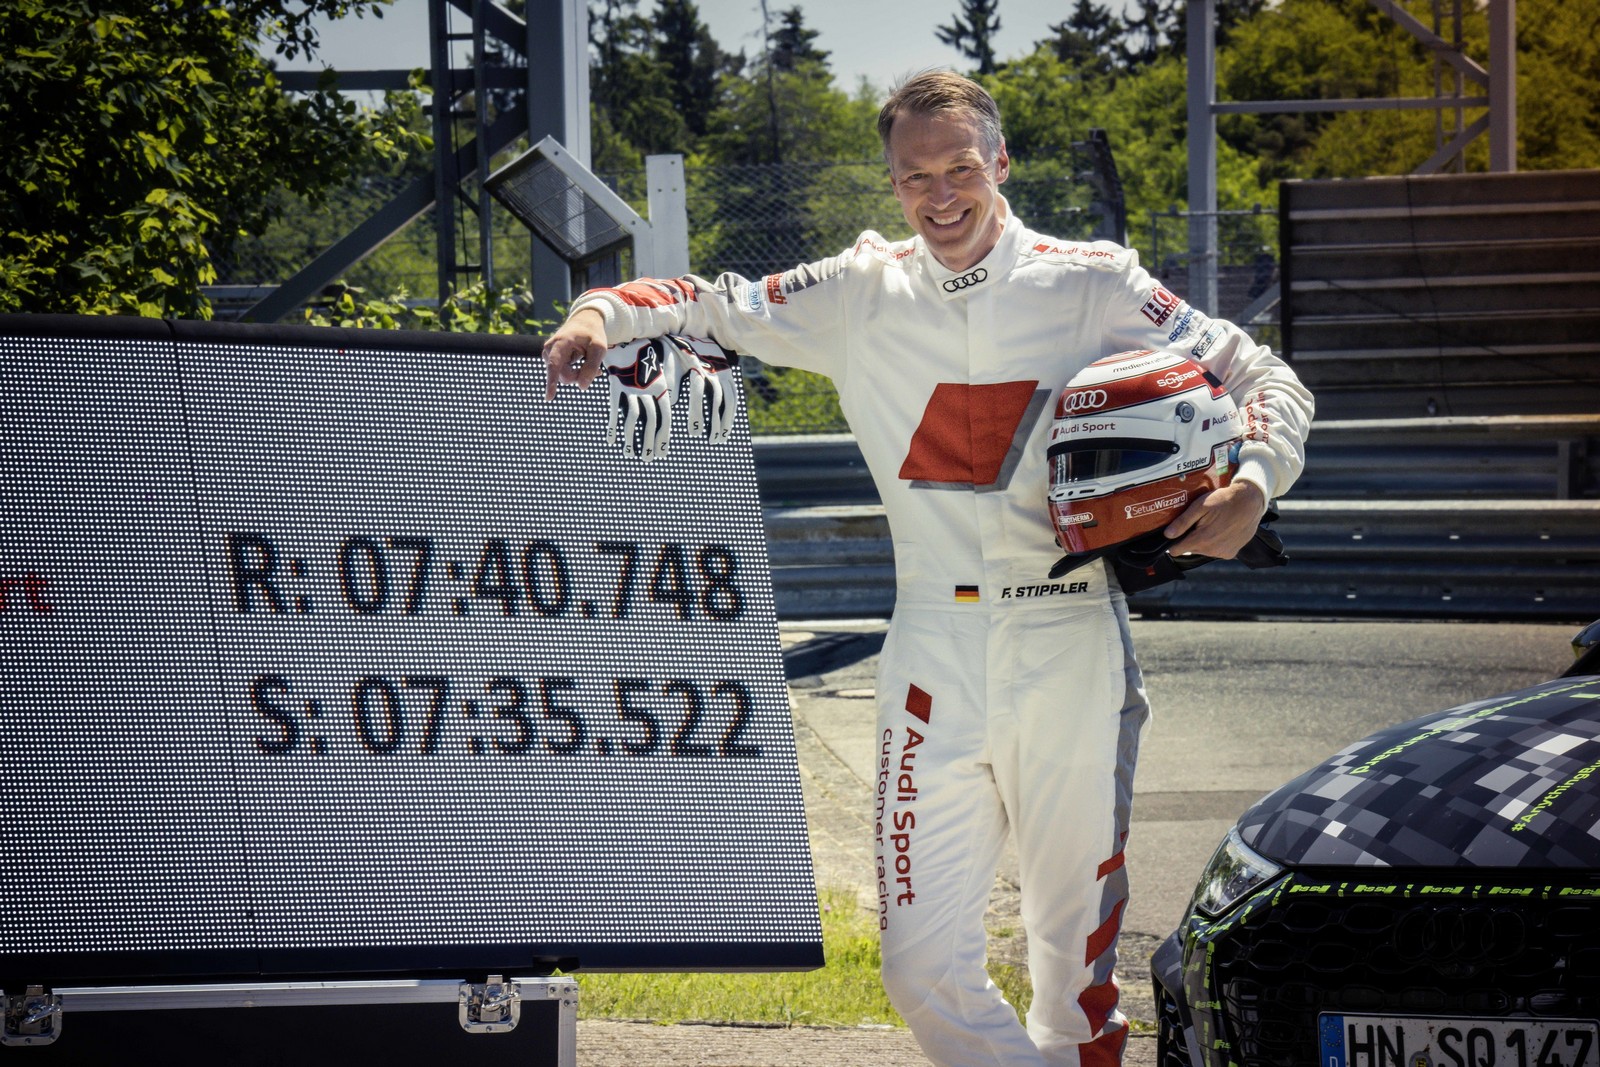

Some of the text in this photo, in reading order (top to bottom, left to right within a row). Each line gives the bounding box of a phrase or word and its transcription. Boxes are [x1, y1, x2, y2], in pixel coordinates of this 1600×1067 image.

[1050, 246, 1116, 261] Audi Sport
[1156, 369, 1200, 388] SCHERER
[1059, 421, 1116, 436] Audi Sport
[1212, 413, 1229, 426] Audi
[1183, 456, 1208, 470] Stippler
[1132, 493, 1186, 516] SetupWizzard
[228, 533, 746, 621] R: 07:40.748
[1001, 581, 1089, 599] F. STIPPLER
[252, 675, 762, 757] S: 07:35.522
[890, 725, 925, 907] Audi Sport
[874, 727, 893, 932] customer racing
[1348, 1023, 1593, 1067] HN SQ 147
